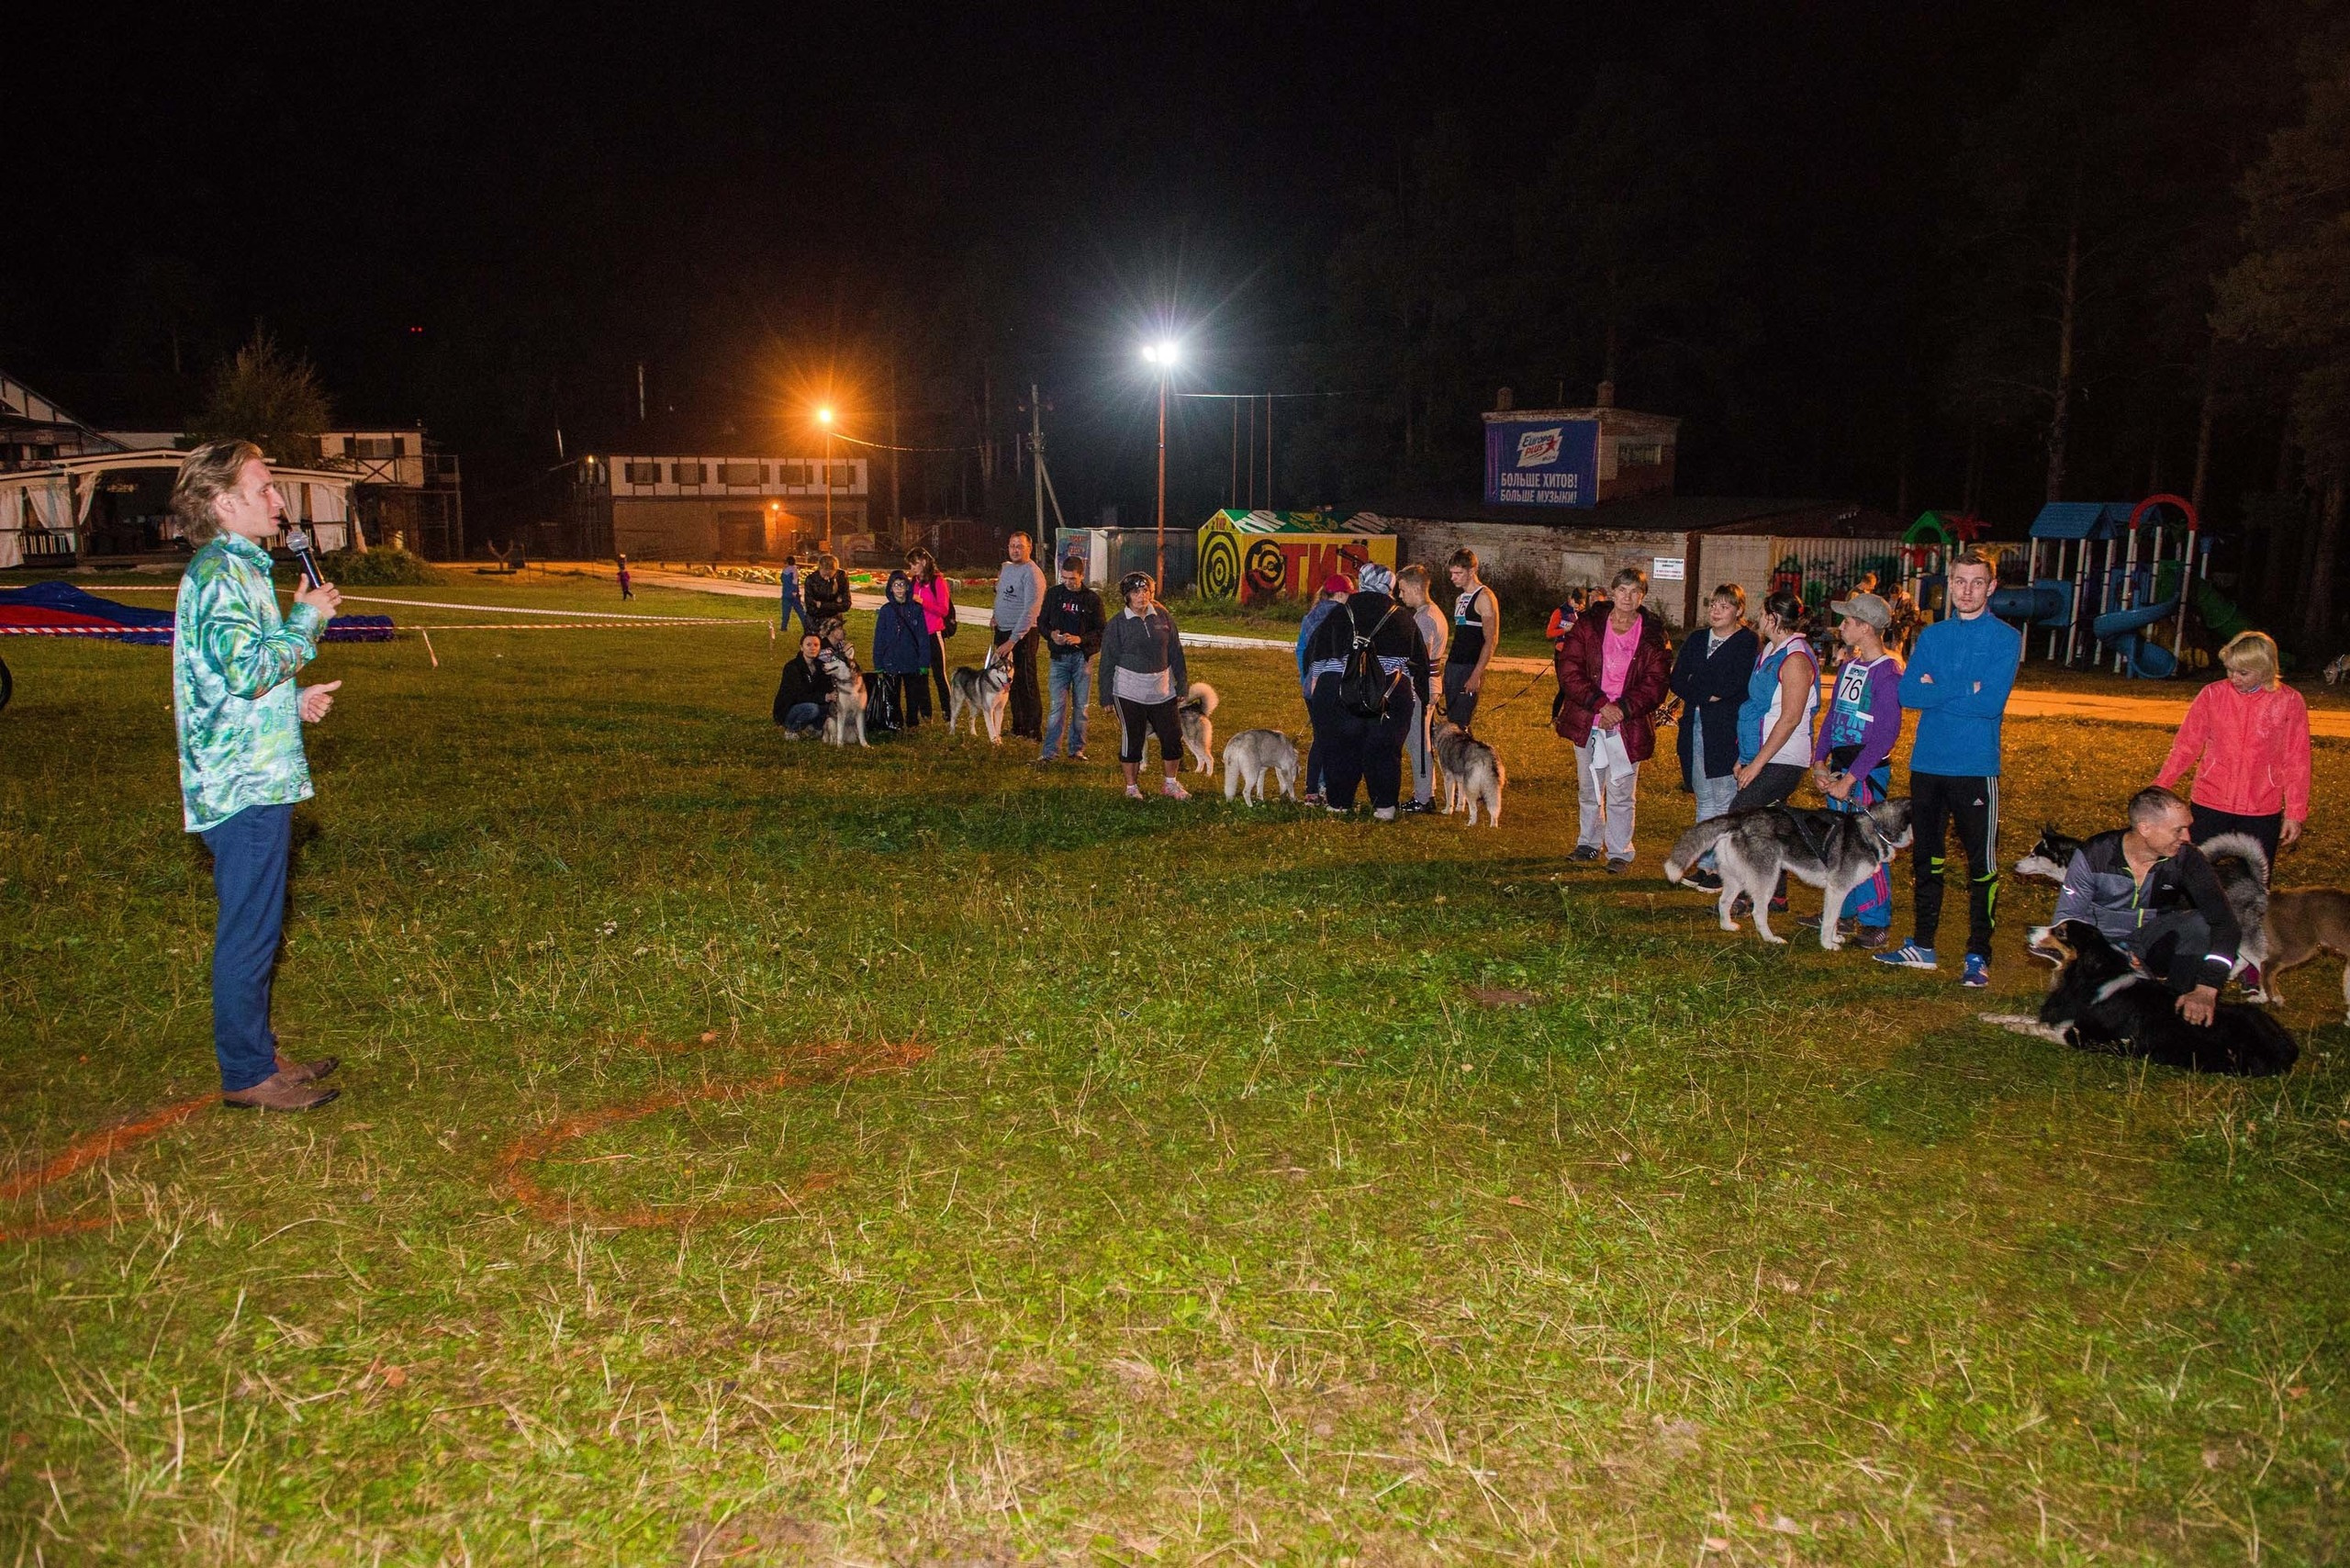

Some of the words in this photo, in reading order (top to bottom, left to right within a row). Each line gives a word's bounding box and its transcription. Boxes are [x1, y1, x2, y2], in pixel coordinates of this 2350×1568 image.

[1501, 473, 1540, 487] БОЛЬШЕ
[1542, 473, 1577, 488] ХИТОВ!
[1500, 489, 1535, 502] БОЛЬШЕ
[1536, 490, 1577, 504] МУЗЫКИ!
[1235, 510, 1286, 532] ТИР
[1339, 511, 1388, 534] ТИР
[1280, 543, 1369, 598] ТИР
[1456, 601, 1469, 615] 75
[1841, 677, 1863, 700] 76
